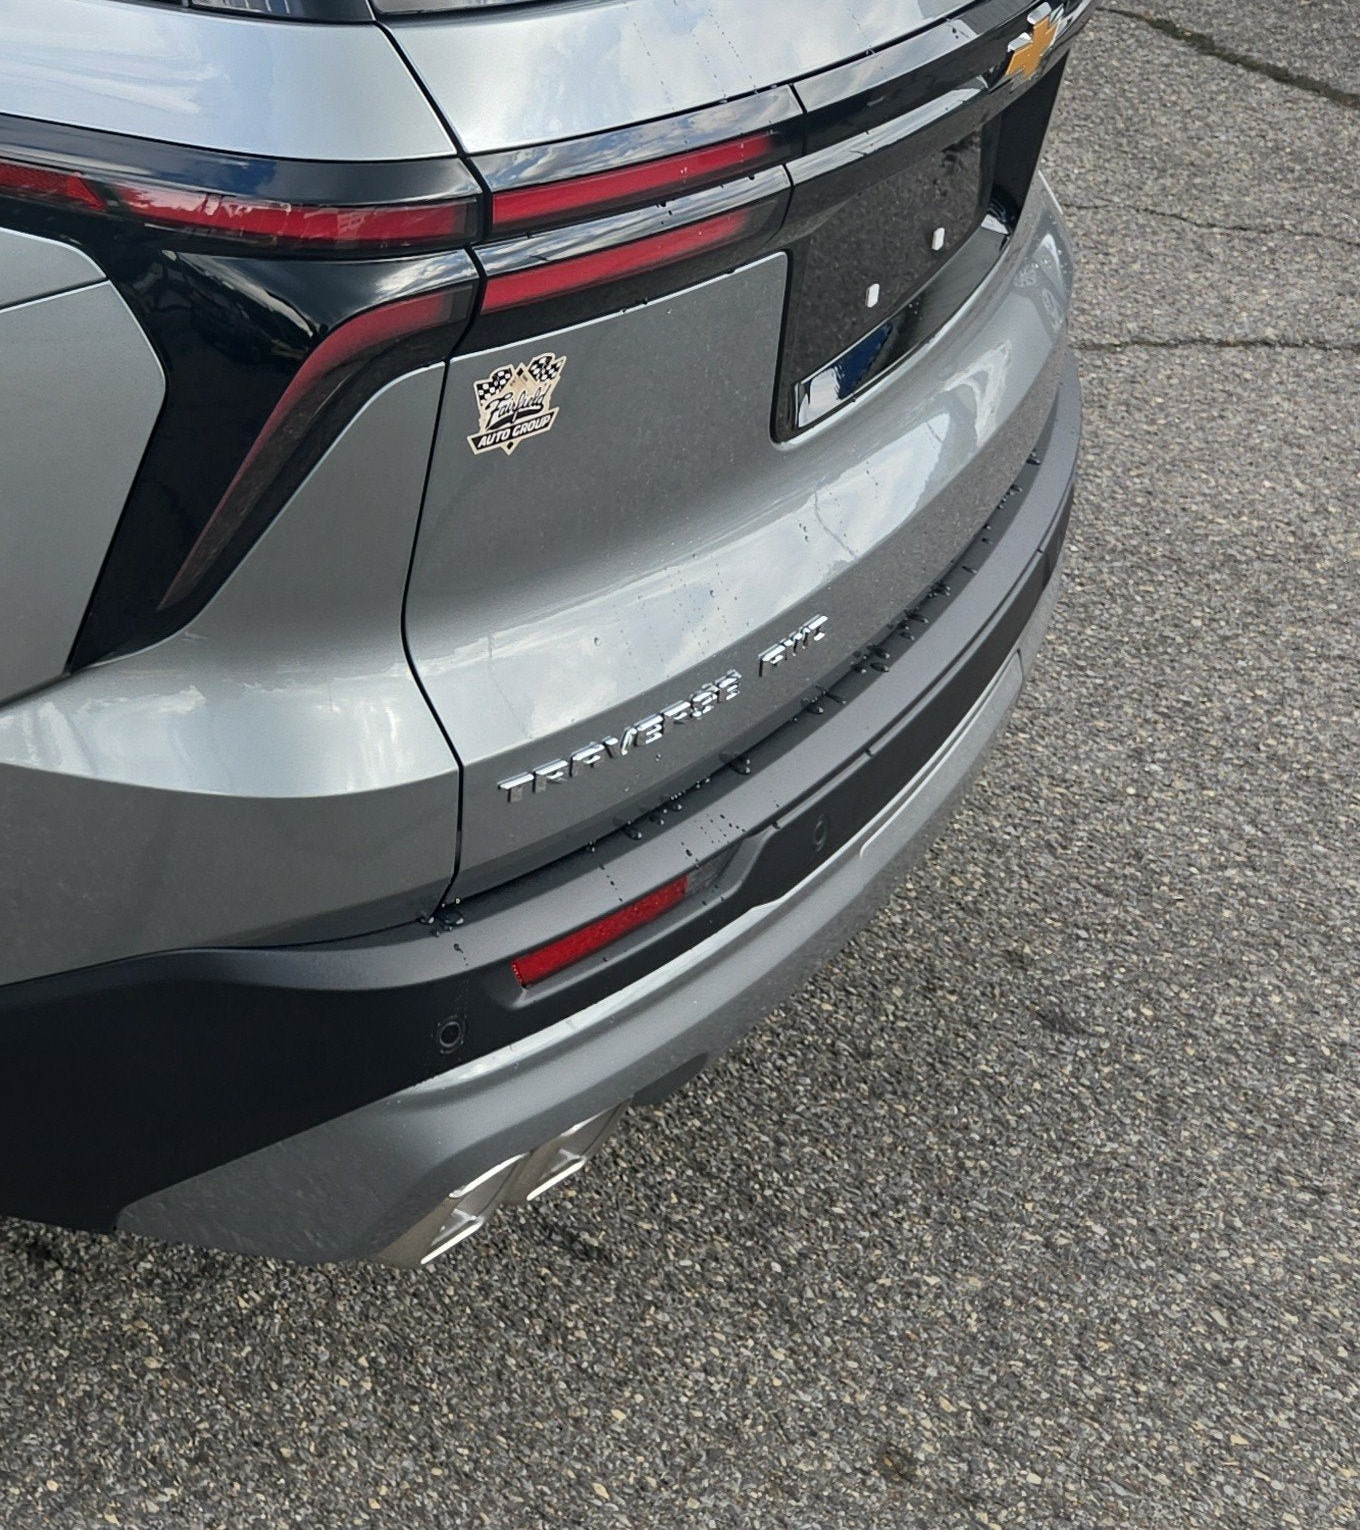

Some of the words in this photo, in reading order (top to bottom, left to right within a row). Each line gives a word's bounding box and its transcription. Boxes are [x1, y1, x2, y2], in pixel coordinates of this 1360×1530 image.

[485, 384, 552, 429] Fairfield
[476, 430, 511, 449] AUTO
[511, 414, 552, 437] GROUP
[497, 669, 742, 803] TRAVERSE
